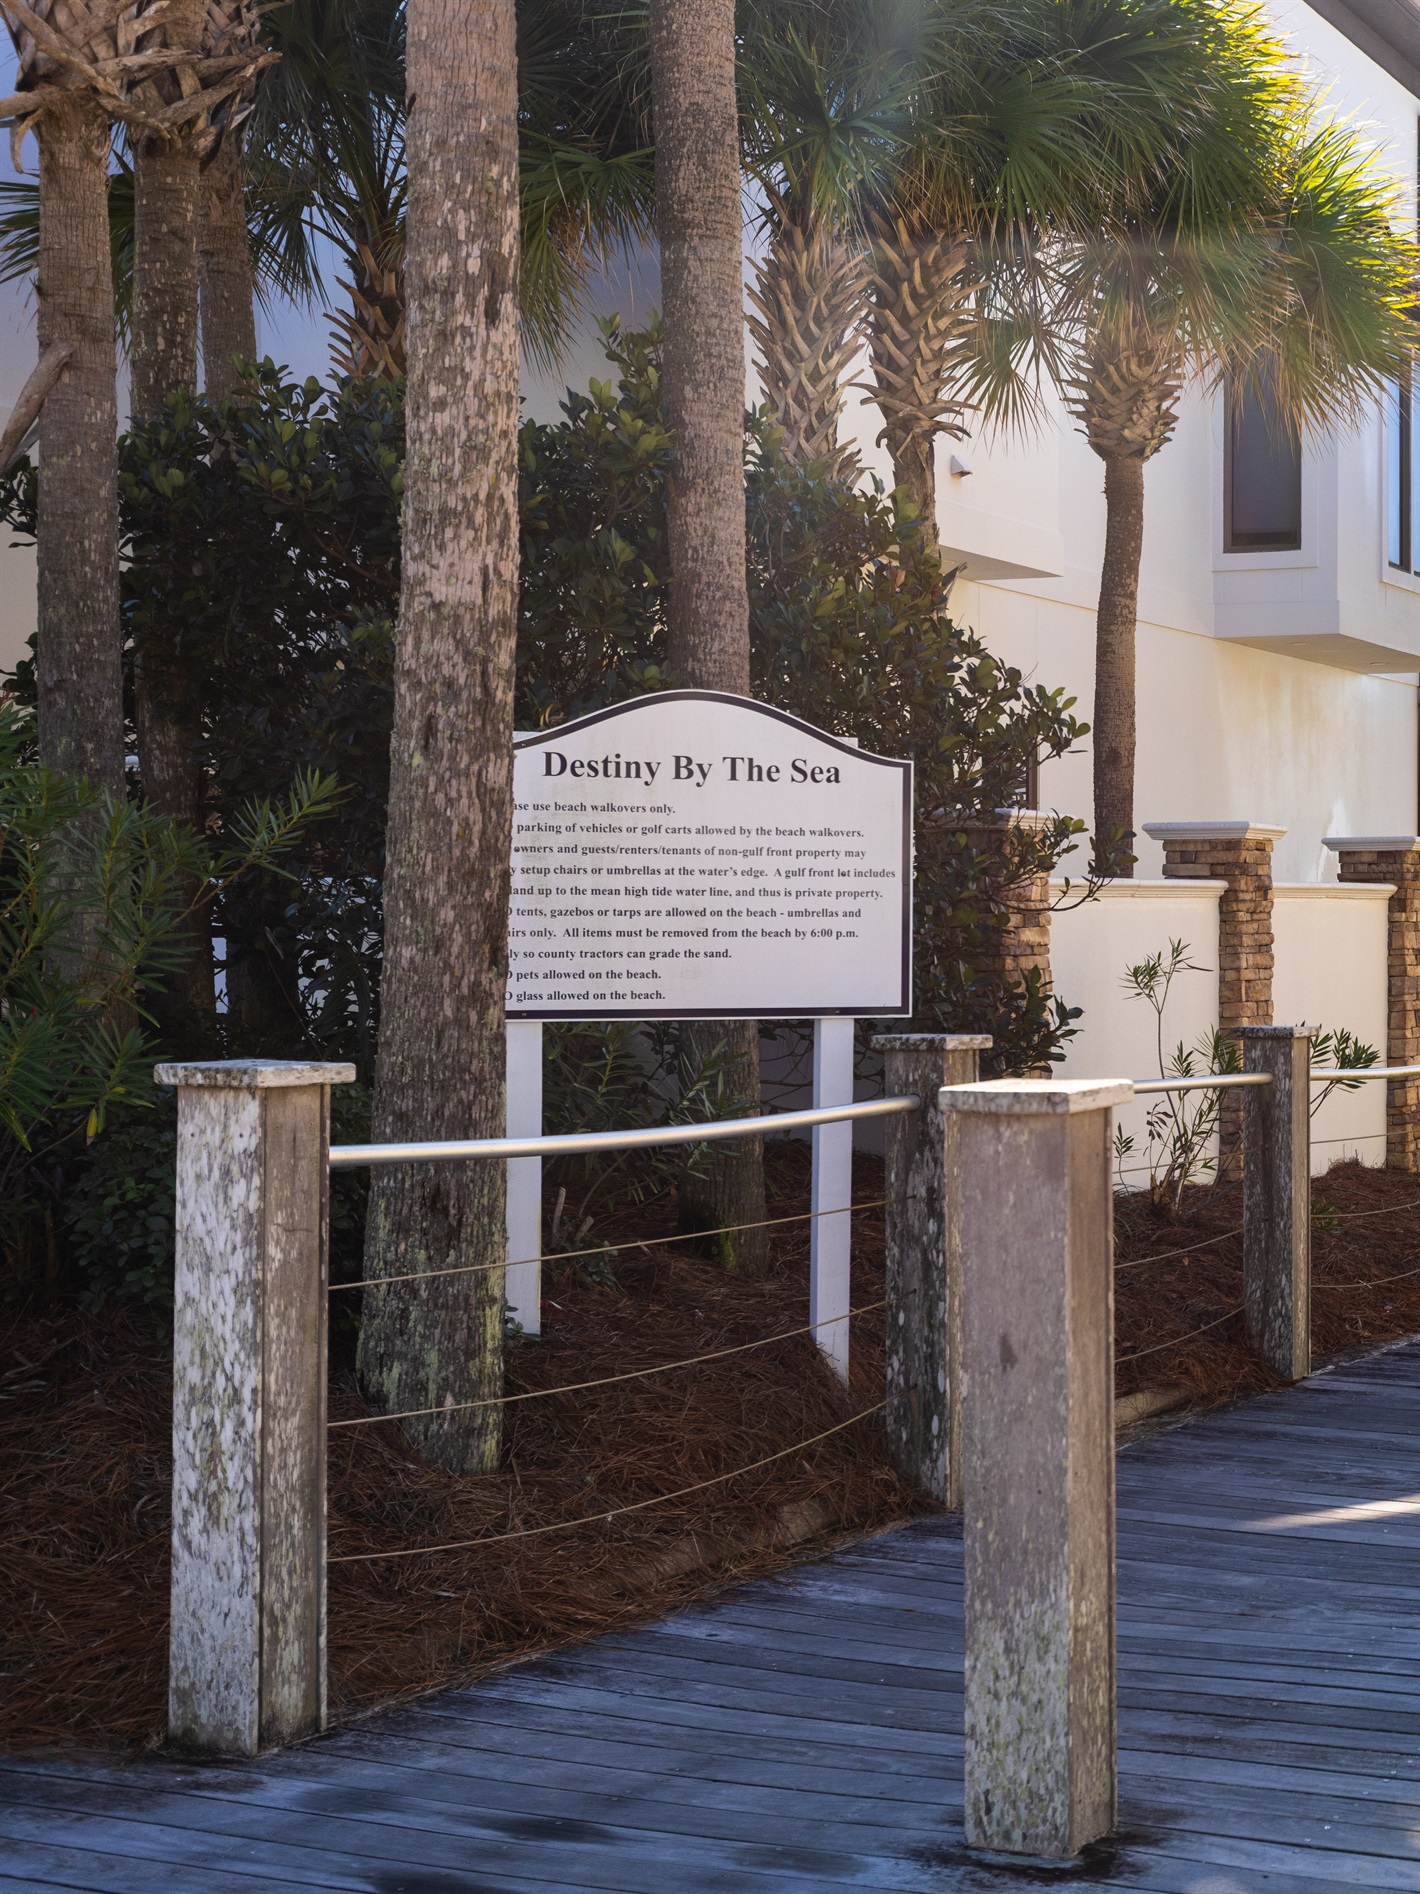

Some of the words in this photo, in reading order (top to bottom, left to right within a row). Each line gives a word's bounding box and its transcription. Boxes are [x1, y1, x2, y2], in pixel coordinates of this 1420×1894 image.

[542, 751, 662, 787] Destiny
[672, 754, 713, 788] By
[722, 756, 781, 783] The
[790, 758, 842, 784] Sea
[512, 802, 530, 812] ase
[532, 803, 551, 812] use
[554, 801, 587, 812] beach
[590, 802, 647, 814] walkovers
[649, 803, 676, 816] only.
[516, 822, 563, 836] parking
[564, 822, 578, 833] of
[579, 822, 623, 834] vehicles
[625, 826, 639, 834] or
[640, 824, 664, 837] golf
[664, 826, 692, 835] carts
[694, 825, 736, 836] allowed
[739, 826, 753, 838] by
[755, 826, 773, 836] the
[775, 826, 806, 837] beach
[808, 827, 864, 838] walkovers.
[513, 844, 554, 854] owners
[556, 843, 578, 854] and
[581, 844, 702, 857] guests/renters/tenants
[704, 845, 716, 856] of
[718, 846, 764, 859] non-gulf
[766, 846, 793, 857] front
[795, 848, 842, 860] property
[844, 850, 866, 860] may
[520, 865, 551, 878] setup
[553, 864, 588, 875] chairs
[590, 867, 604, 875] or
[606, 865, 662, 876] umbrellas
[664, 867, 675, 876] at
[678, 866, 696, 876] the
[698, 866, 738, 877] water's
[740, 866, 768, 880] edge.
[773, 868, 782, 877] A
[784, 867, 807, 880] gulf
[808, 867, 834, 878] front
[837, 868, 851, 878] lot
[854, 868, 896, 878] includes
[509, 885, 534, 896] land
[537, 888, 553, 898] up
[555, 886, 567, 896] to
[569, 885, 588, 896] the
[590, 888, 621, 896] mean
[624, 886, 649, 899] high
[651, 886, 673, 897] tide
[675, 888, 707, 897] water
[709, 886, 732, 898] line,
[735, 887, 756, 897] and
[758, 887, 782, 898] thus
[784, 887, 793, 898] is
[795, 887, 833, 900] private
[835, 889, 883, 900] property.
[516, 907, 547, 918] tents,
[550, 906, 594, 920] gazebos
[596, 909, 610, 917] or
[612, 908, 642, 920] tarps
[644, 909, 663, 917] are
[665, 907, 707, 918] allowed
[709, 909, 723, 918] on
[726, 907, 744, 918] the
[746, 907, 777, 918] beach
[787, 908, 840, 918] umbrellas
[842, 908, 862, 918] and
[529, 927, 557, 940] only.
[562, 927, 580, 938] All
[582, 927, 613, 938] items
[615, 928, 643, 938] must
[645, 927, 659, 938] be
[662, 927, 709, 938] removed
[712, 927, 738, 938] from
[741, 928, 758, 938] the
[760, 928, 792, 938] beach
[794, 928, 808, 940] by
[810, 928, 833, 938] 6:00
[835, 930, 859, 940] p.m.
[522, 950, 536, 959] so
[538, 949, 577, 962] county
[579, 949, 624, 959] tractors
[626, 950, 646, 959] can
[648, 948, 681, 961] grade
[683, 948, 701, 959] the
[703, 948, 732, 959] sand.
[516, 970, 540, 983] pets
[542, 969, 586, 980] allowed
[588, 972, 602, 980] on
[605, 969, 624, 980] the
[626, 969, 662, 980] beach.
[516, 990, 544, 1004] glass
[546, 990, 590, 1001] allowed
[592, 992, 607, 1001] on
[609, 990, 628, 1000] the
[630, 990, 666, 1000] beach.
